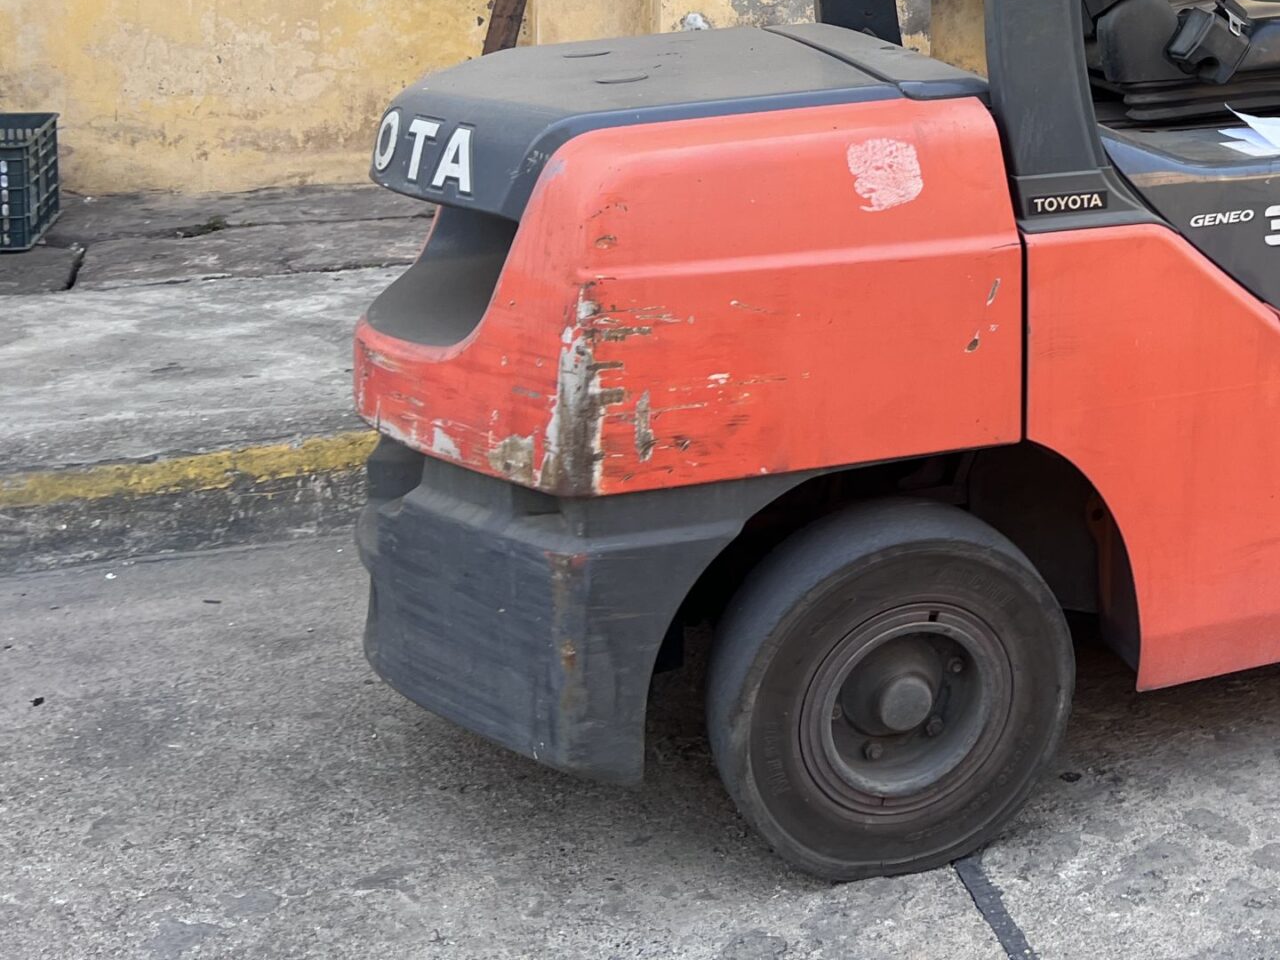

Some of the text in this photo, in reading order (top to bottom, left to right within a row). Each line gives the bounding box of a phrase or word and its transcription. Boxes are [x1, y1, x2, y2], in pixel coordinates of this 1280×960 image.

[374, 110, 472, 193] OTA
[1034, 194, 1103, 214] TOYOTA
[1190, 209, 1255, 228] GENEO
